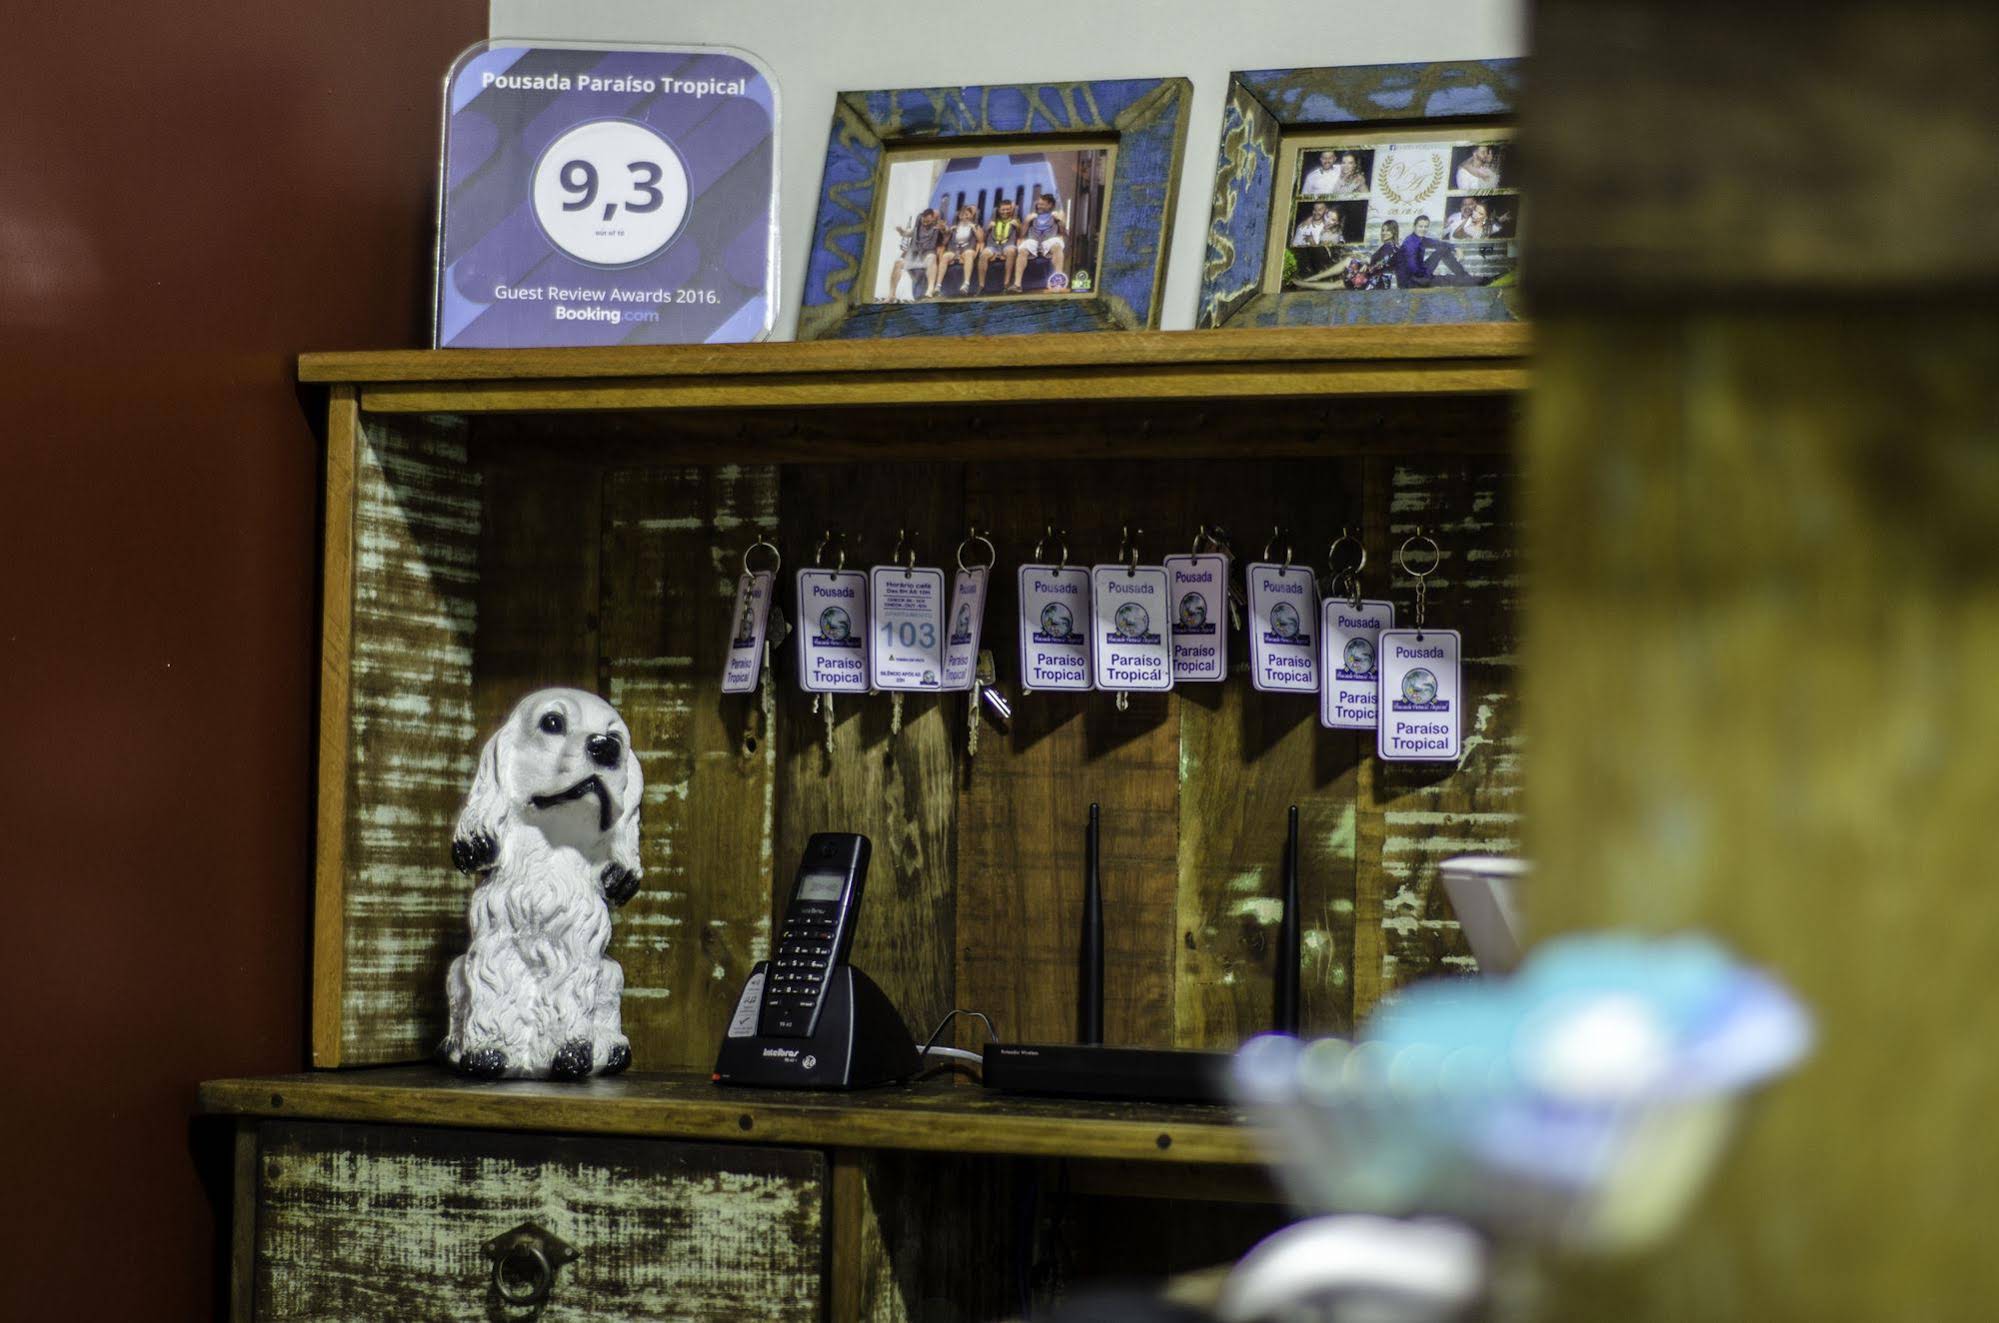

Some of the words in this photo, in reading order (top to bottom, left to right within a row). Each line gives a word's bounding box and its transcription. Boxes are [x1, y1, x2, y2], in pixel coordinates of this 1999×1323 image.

[482, 71, 571, 91] Pousada
[578, 73, 656, 93] Paraíso
[661, 76, 746, 98] Tropical
[558, 158, 664, 221] 9,3
[494, 284, 544, 301] Guest
[548, 286, 606, 302] Review
[610, 287, 671, 303] Awards
[675, 289, 721, 304] 2016.
[555, 305, 660, 324] Booking.com
[1175, 570, 1213, 583] Pousada
[813, 585, 855, 599] Pousada
[1034, 580, 1079, 595] Pousada
[1108, 581, 1155, 595] Pousada
[1263, 580, 1303, 594] Pousada
[1338, 616, 1381, 629] Pousada
[881, 621, 936, 649] 103
[1174, 644, 1215, 657] Paraíso
[1396, 646, 1444, 659] Pousada
[1110, 653, 1162, 667] Paraíso
[813, 670, 863, 685] Tropical
[1033, 667, 1085, 682] Tropical
[1265, 668, 1312, 684] Tropical
[1339, 690, 1378, 704] Paraís
[1396, 722, 1449, 735] Paraíso
[1392, 737, 1449, 752] Tropical
